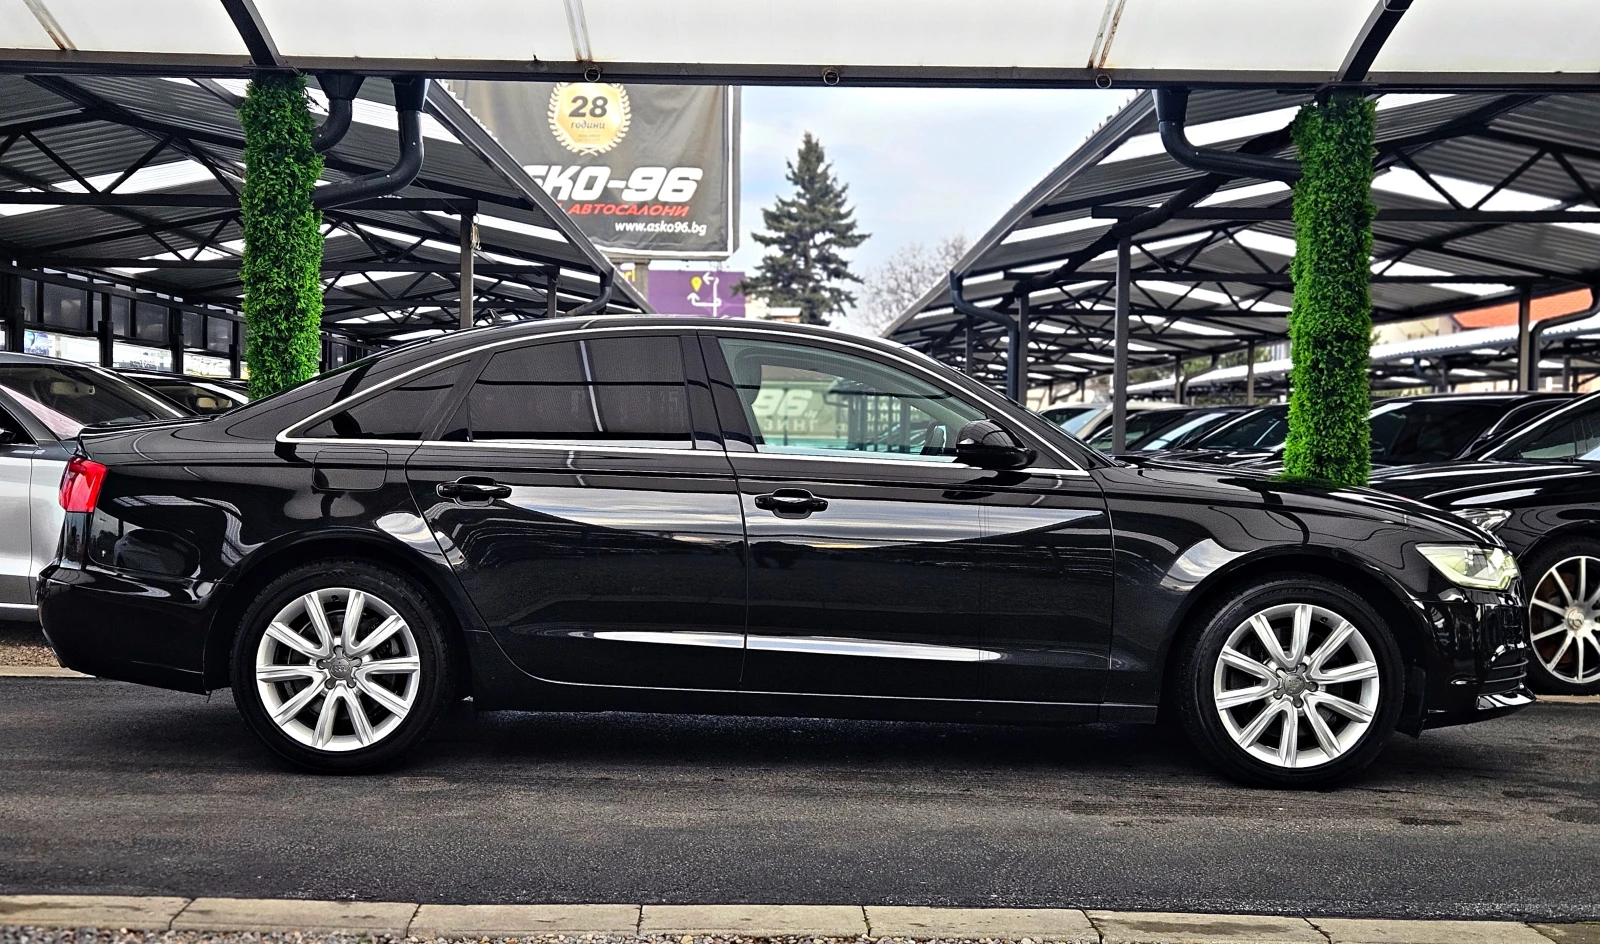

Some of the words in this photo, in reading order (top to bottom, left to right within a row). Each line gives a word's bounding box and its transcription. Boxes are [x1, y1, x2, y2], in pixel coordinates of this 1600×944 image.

[568, 95, 608, 118] 28
[570, 119, 606, 129] години
[567, 202, 690, 217] АВТОСАЛОНИ
[614, 219, 708, 237] www.asko96.bg
